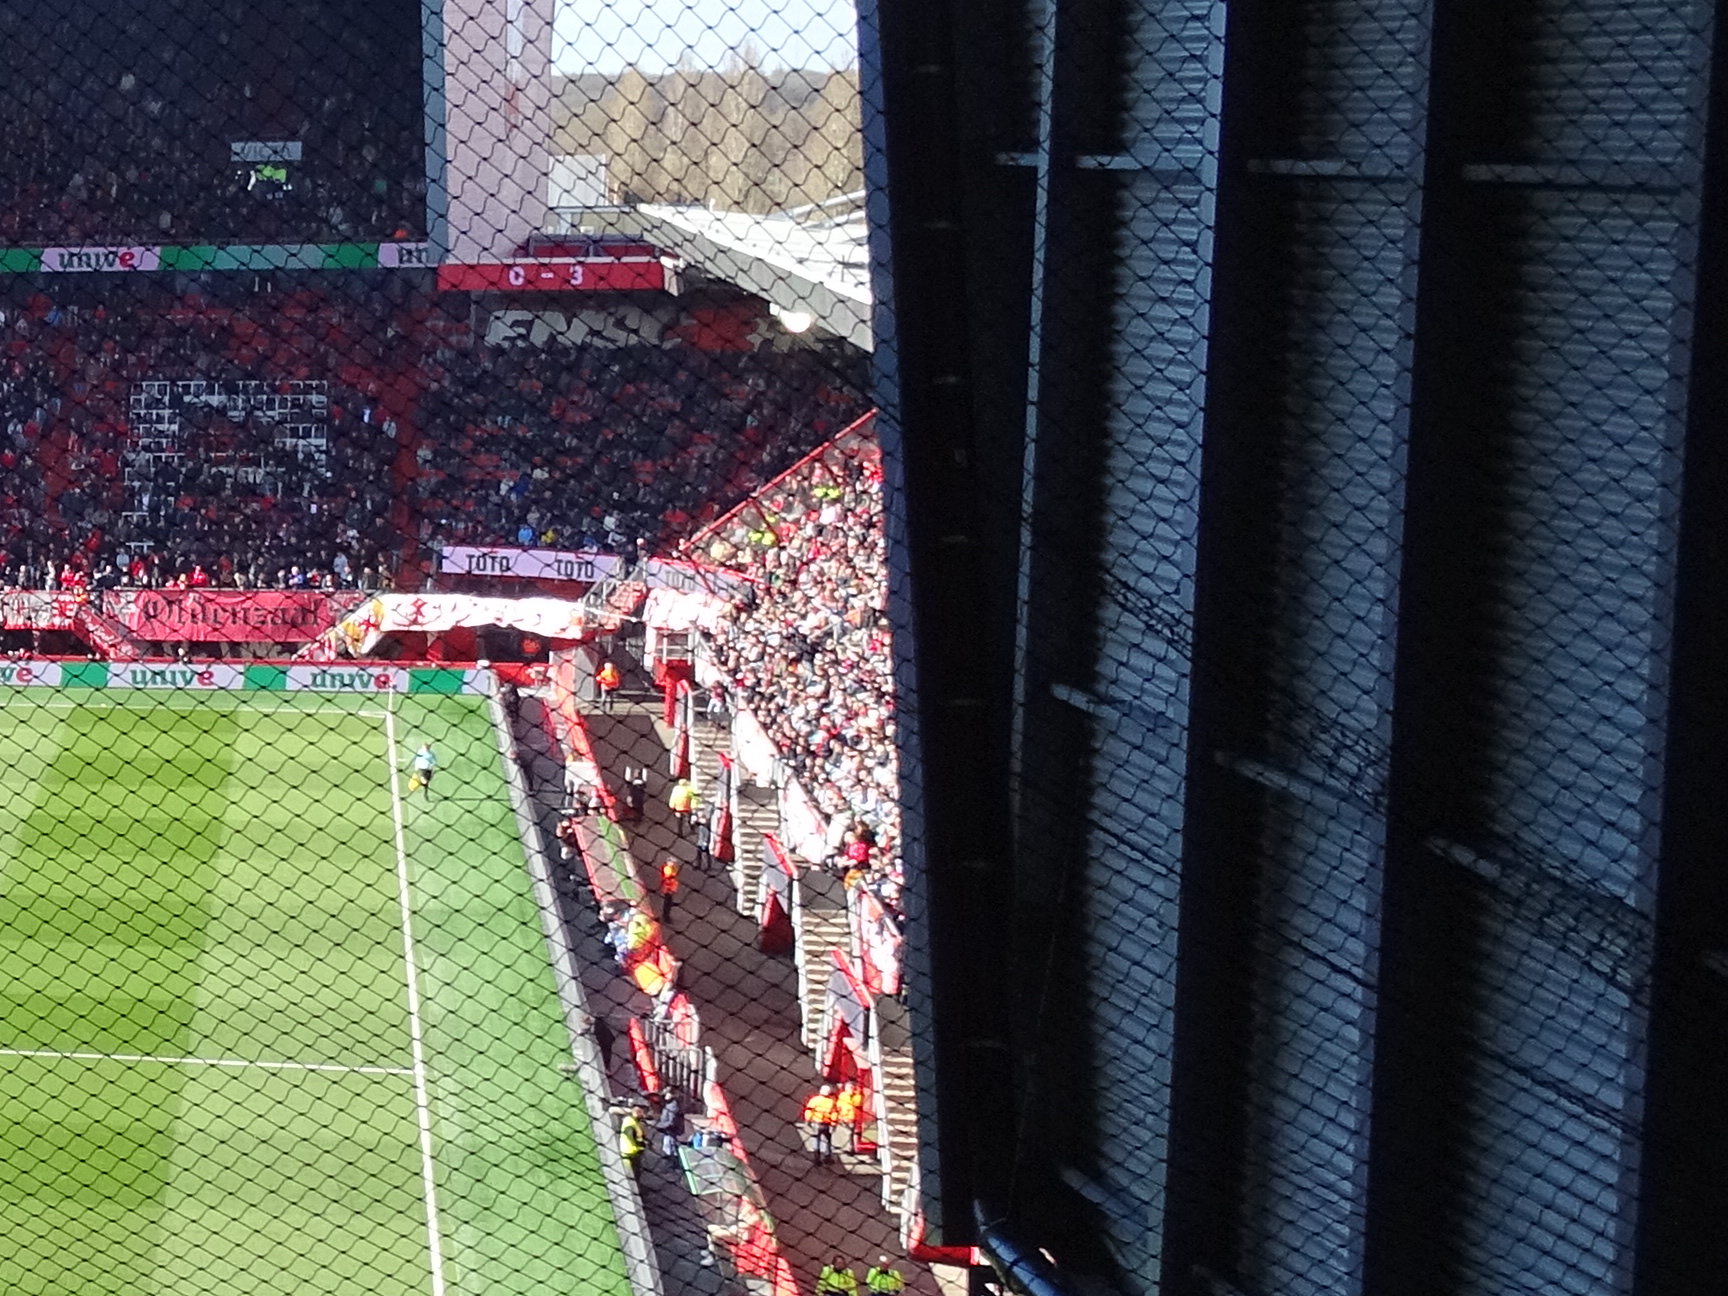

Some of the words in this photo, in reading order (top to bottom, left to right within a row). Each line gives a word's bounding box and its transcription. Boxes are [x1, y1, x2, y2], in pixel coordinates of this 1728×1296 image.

[569, 265, 583, 285] 3
[466, 555, 510, 572] TOTO
[556, 559, 594, 578] TOTO
